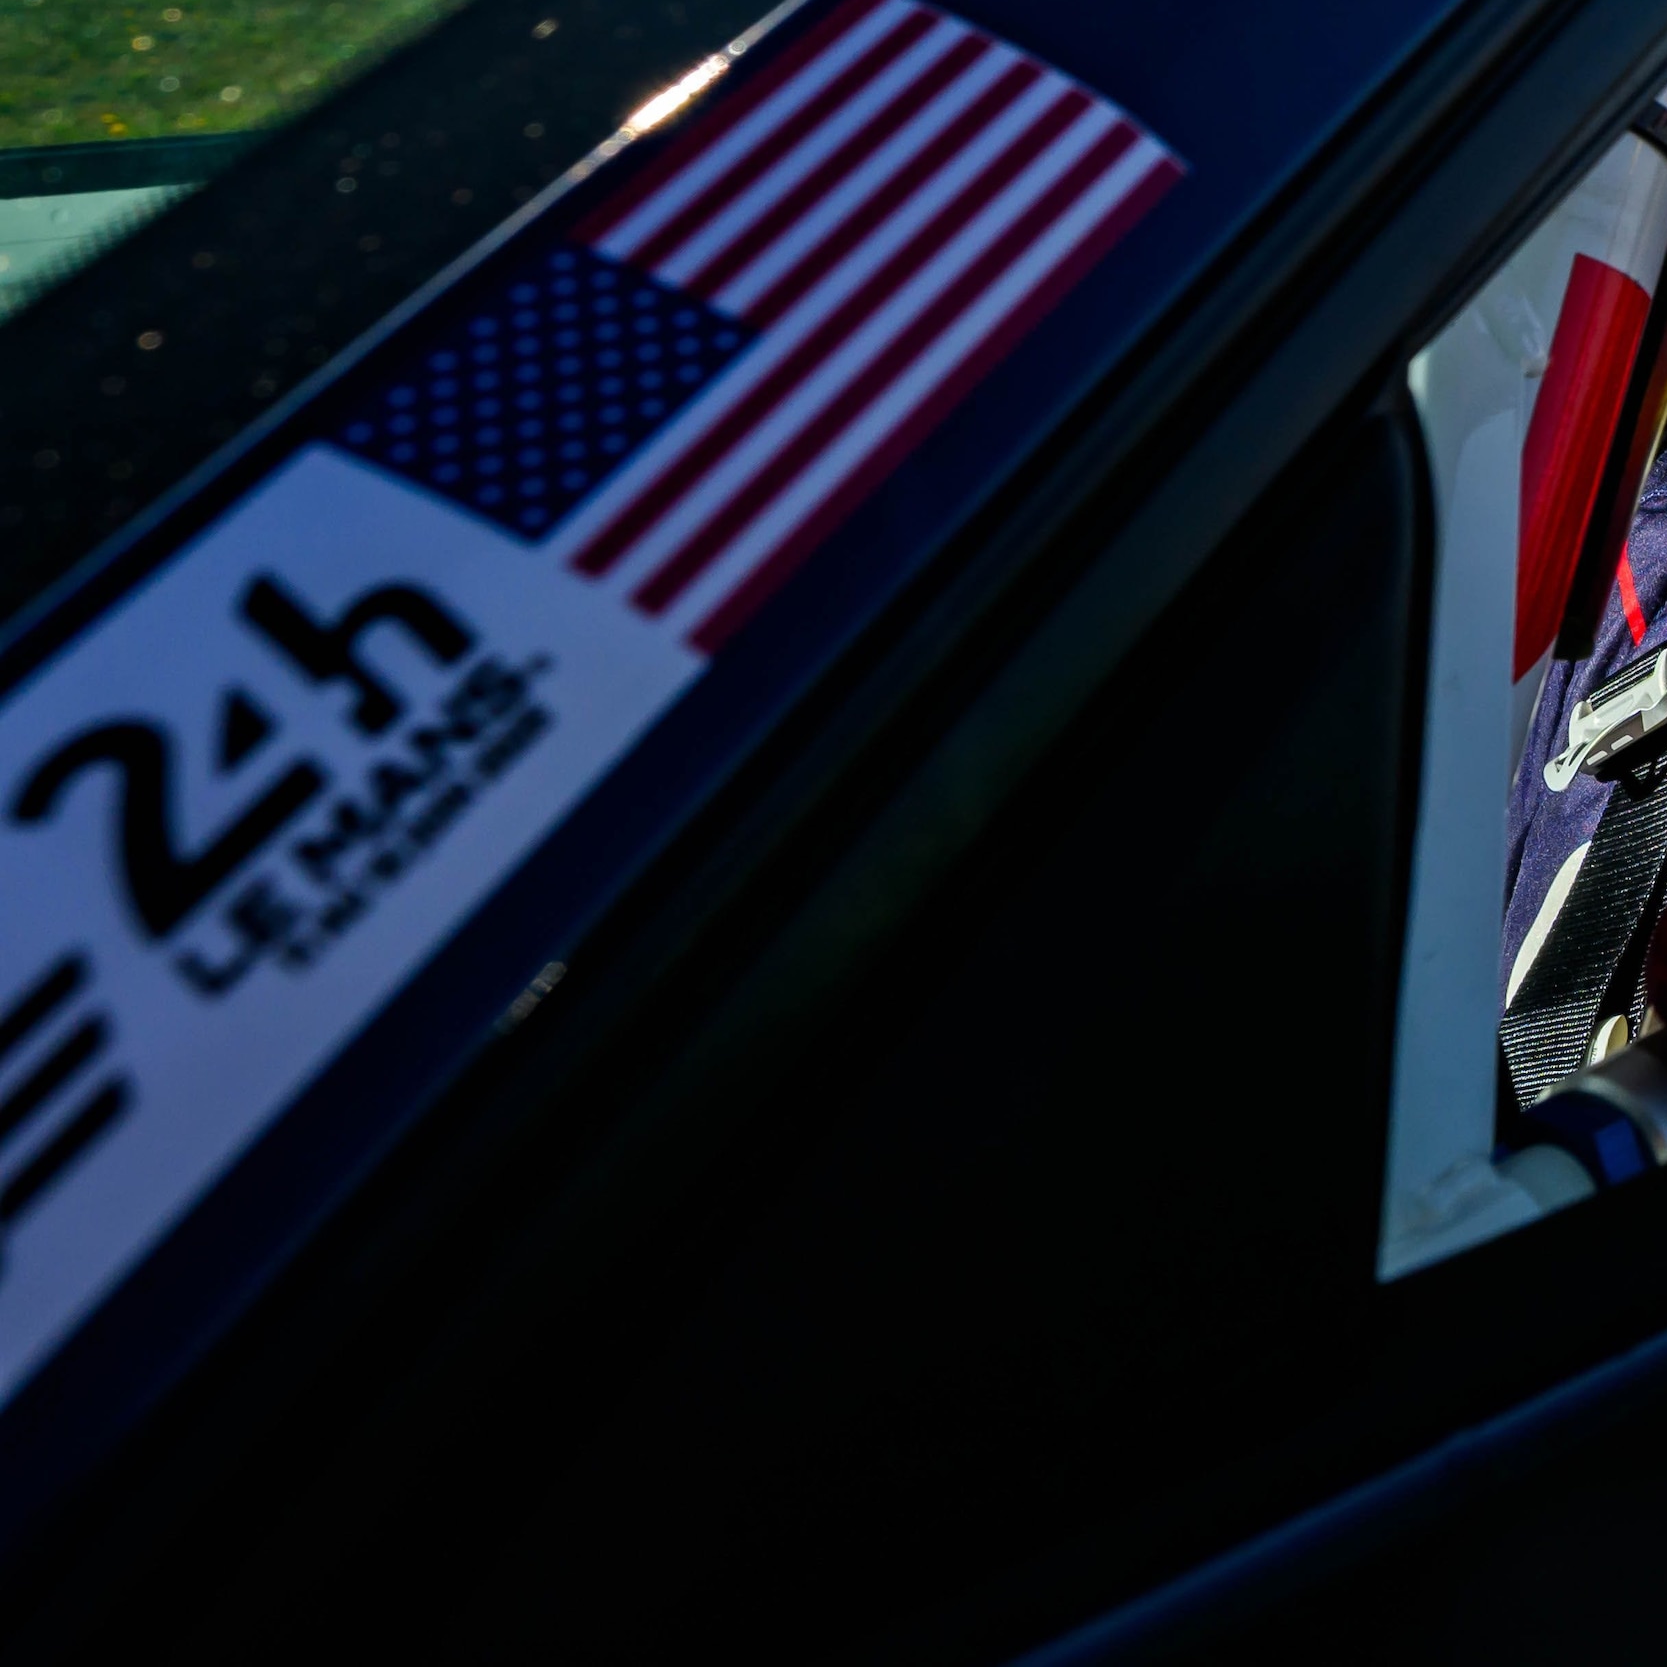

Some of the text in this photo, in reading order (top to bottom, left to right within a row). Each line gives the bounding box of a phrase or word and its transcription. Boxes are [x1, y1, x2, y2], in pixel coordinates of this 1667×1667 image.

[10, 569, 480, 940] 24h
[174, 876, 302, 998] LE
[293, 654, 540, 879] MANS
